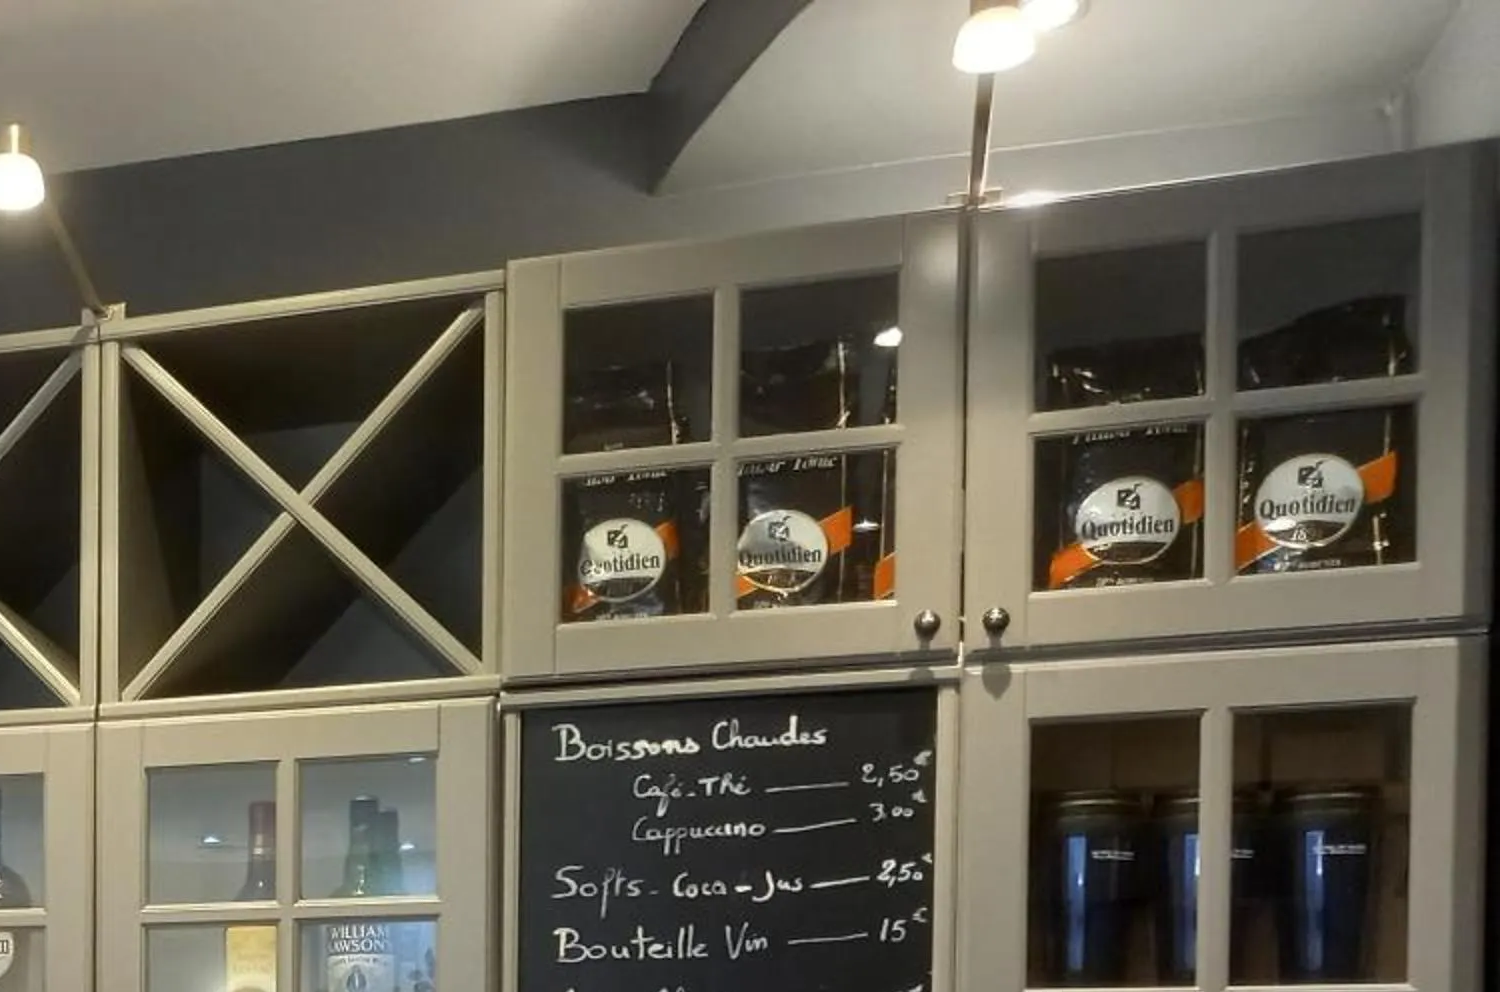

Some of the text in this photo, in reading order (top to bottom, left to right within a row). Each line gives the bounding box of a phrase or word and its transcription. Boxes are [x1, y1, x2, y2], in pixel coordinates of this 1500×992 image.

[1260, 494, 1356, 519] Quotidien
[1082, 515, 1175, 541] Quotidien
[552, 715, 827, 761] Boissons Chaudes
[632, 816, 766, 855] Cappuccino
[553, 924, 709, 963] Bouteille
[725, 921, 769, 959] Vin
